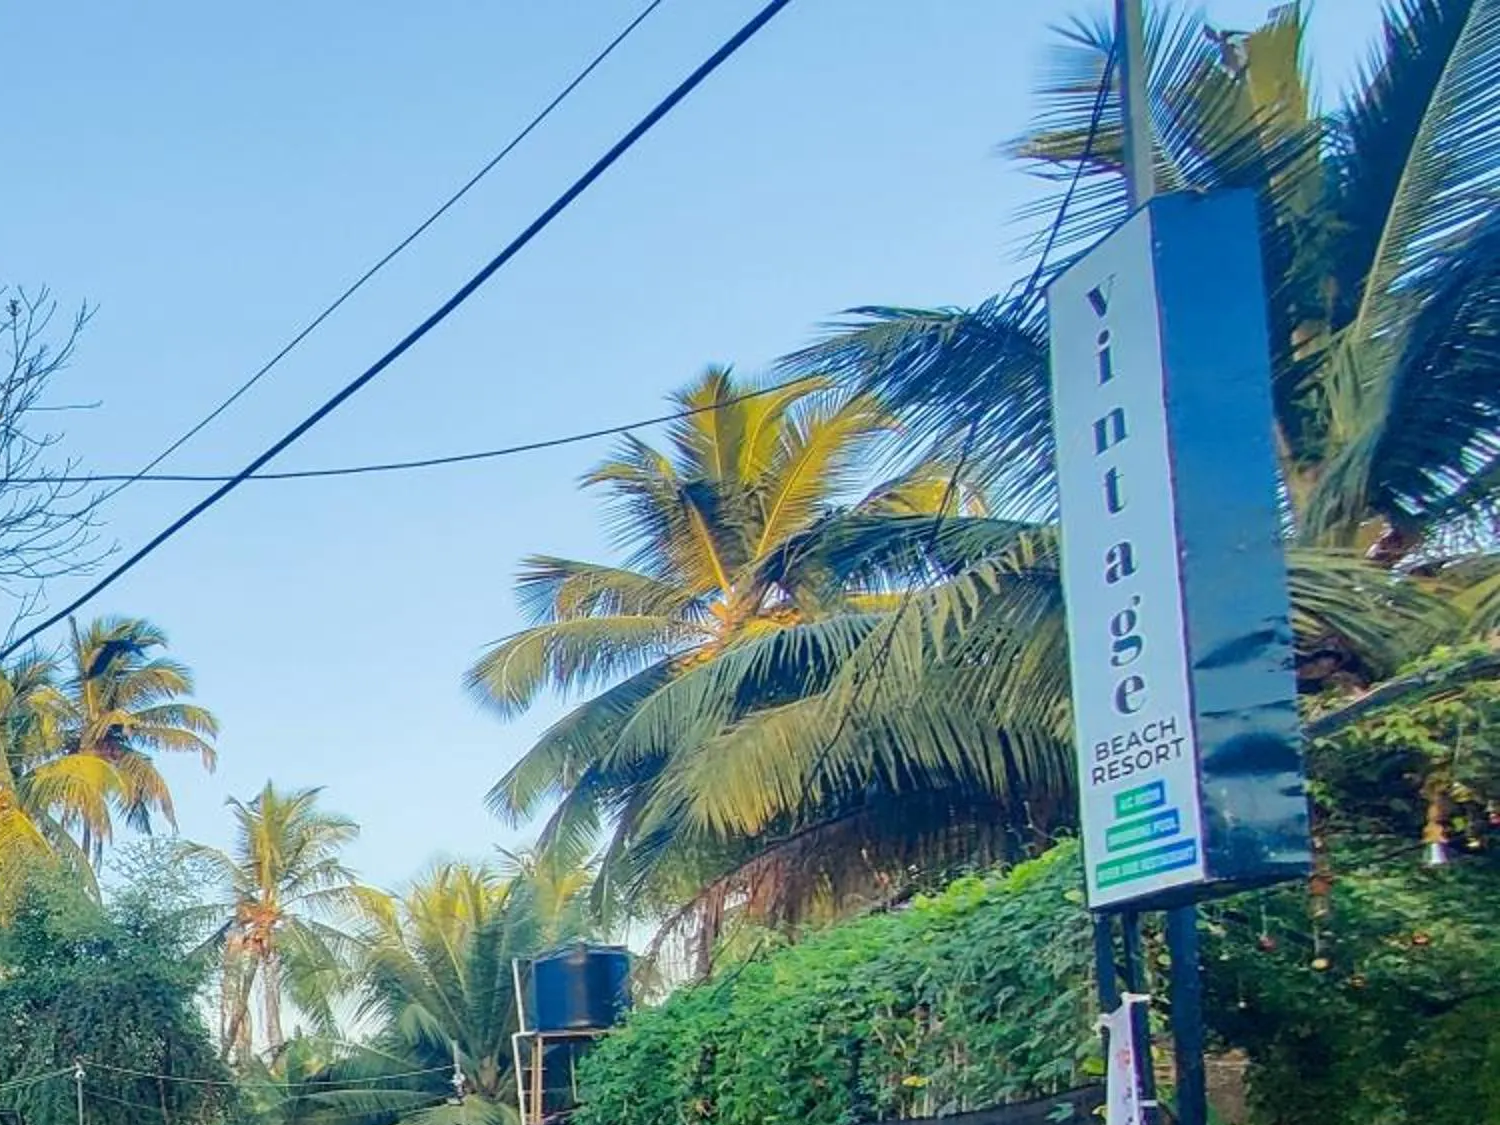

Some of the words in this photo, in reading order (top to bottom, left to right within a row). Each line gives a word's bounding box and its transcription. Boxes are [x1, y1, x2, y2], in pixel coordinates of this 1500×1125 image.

[1086, 273, 1146, 716] vintage
[1091, 737, 1185, 786] RESORT
[1095, 715, 1177, 762] BEACH
